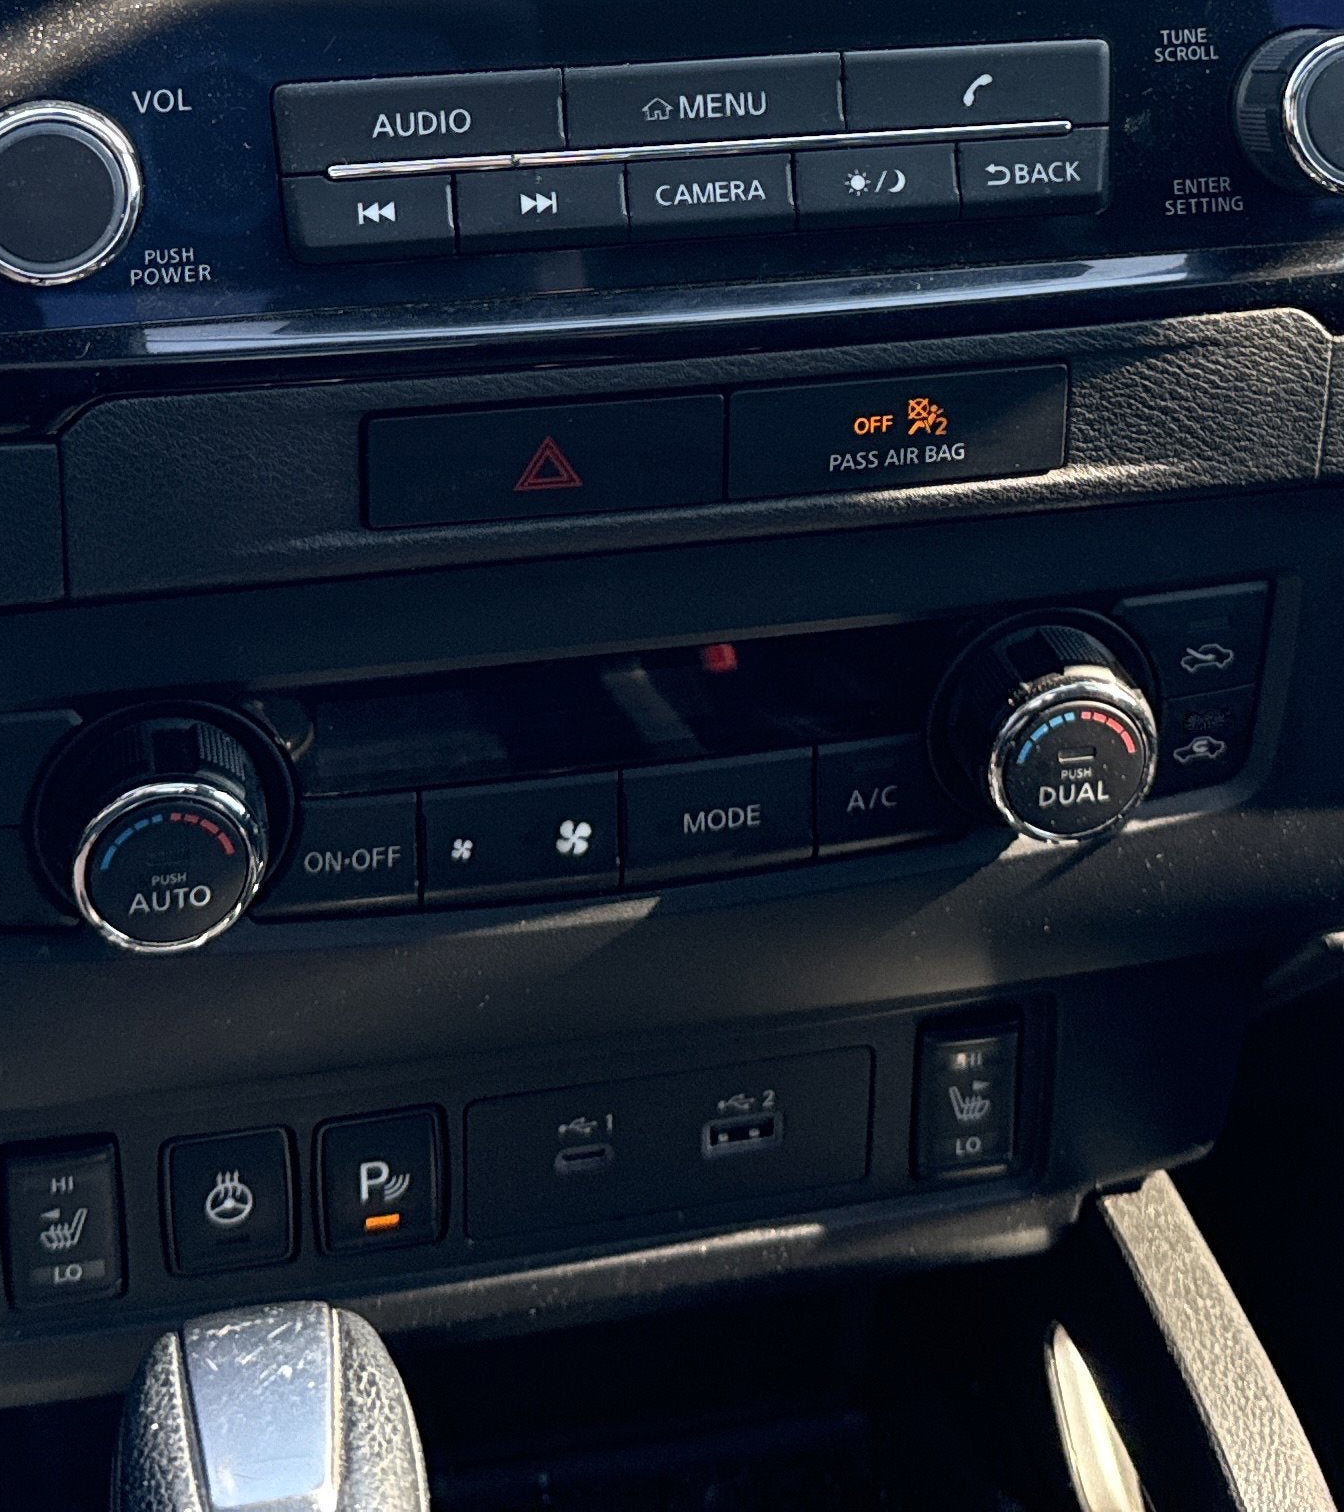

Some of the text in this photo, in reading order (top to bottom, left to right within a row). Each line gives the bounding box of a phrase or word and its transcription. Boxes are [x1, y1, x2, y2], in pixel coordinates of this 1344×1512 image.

[1160, 28, 1207, 46] TUNE
[1155, 44, 1219, 63] SCROLL
[132, 89, 192, 113] VOL
[680, 91, 767, 119] MENU
[372, 109, 471, 138] AUDIO
[1014, 161, 1080, 185] BACK
[656, 180, 766, 206] CAMERA
[1173, 177, 1231, 195] ENTER
[1165, 194, 1243, 216] SETTING
[144, 248, 195, 264] PUSH
[131, 264, 211, 286] POWER
[854, 415, 893, 435] OFF
[829, 443, 965, 472] PASS AIR BAG
[1060, 767, 1092, 780] PUSH
[847, 786, 897, 811] A/C
[1039, 780, 1109, 806] DUAL
[683, 804, 761, 833] MODE
[151, 872, 187, 886] PUSH
[129, 885, 211, 915] AUTO
[956, 1136, 981, 1155] LO
[51, 1175, 73, 1193] HI
[54, 1263, 82, 1284] LO
